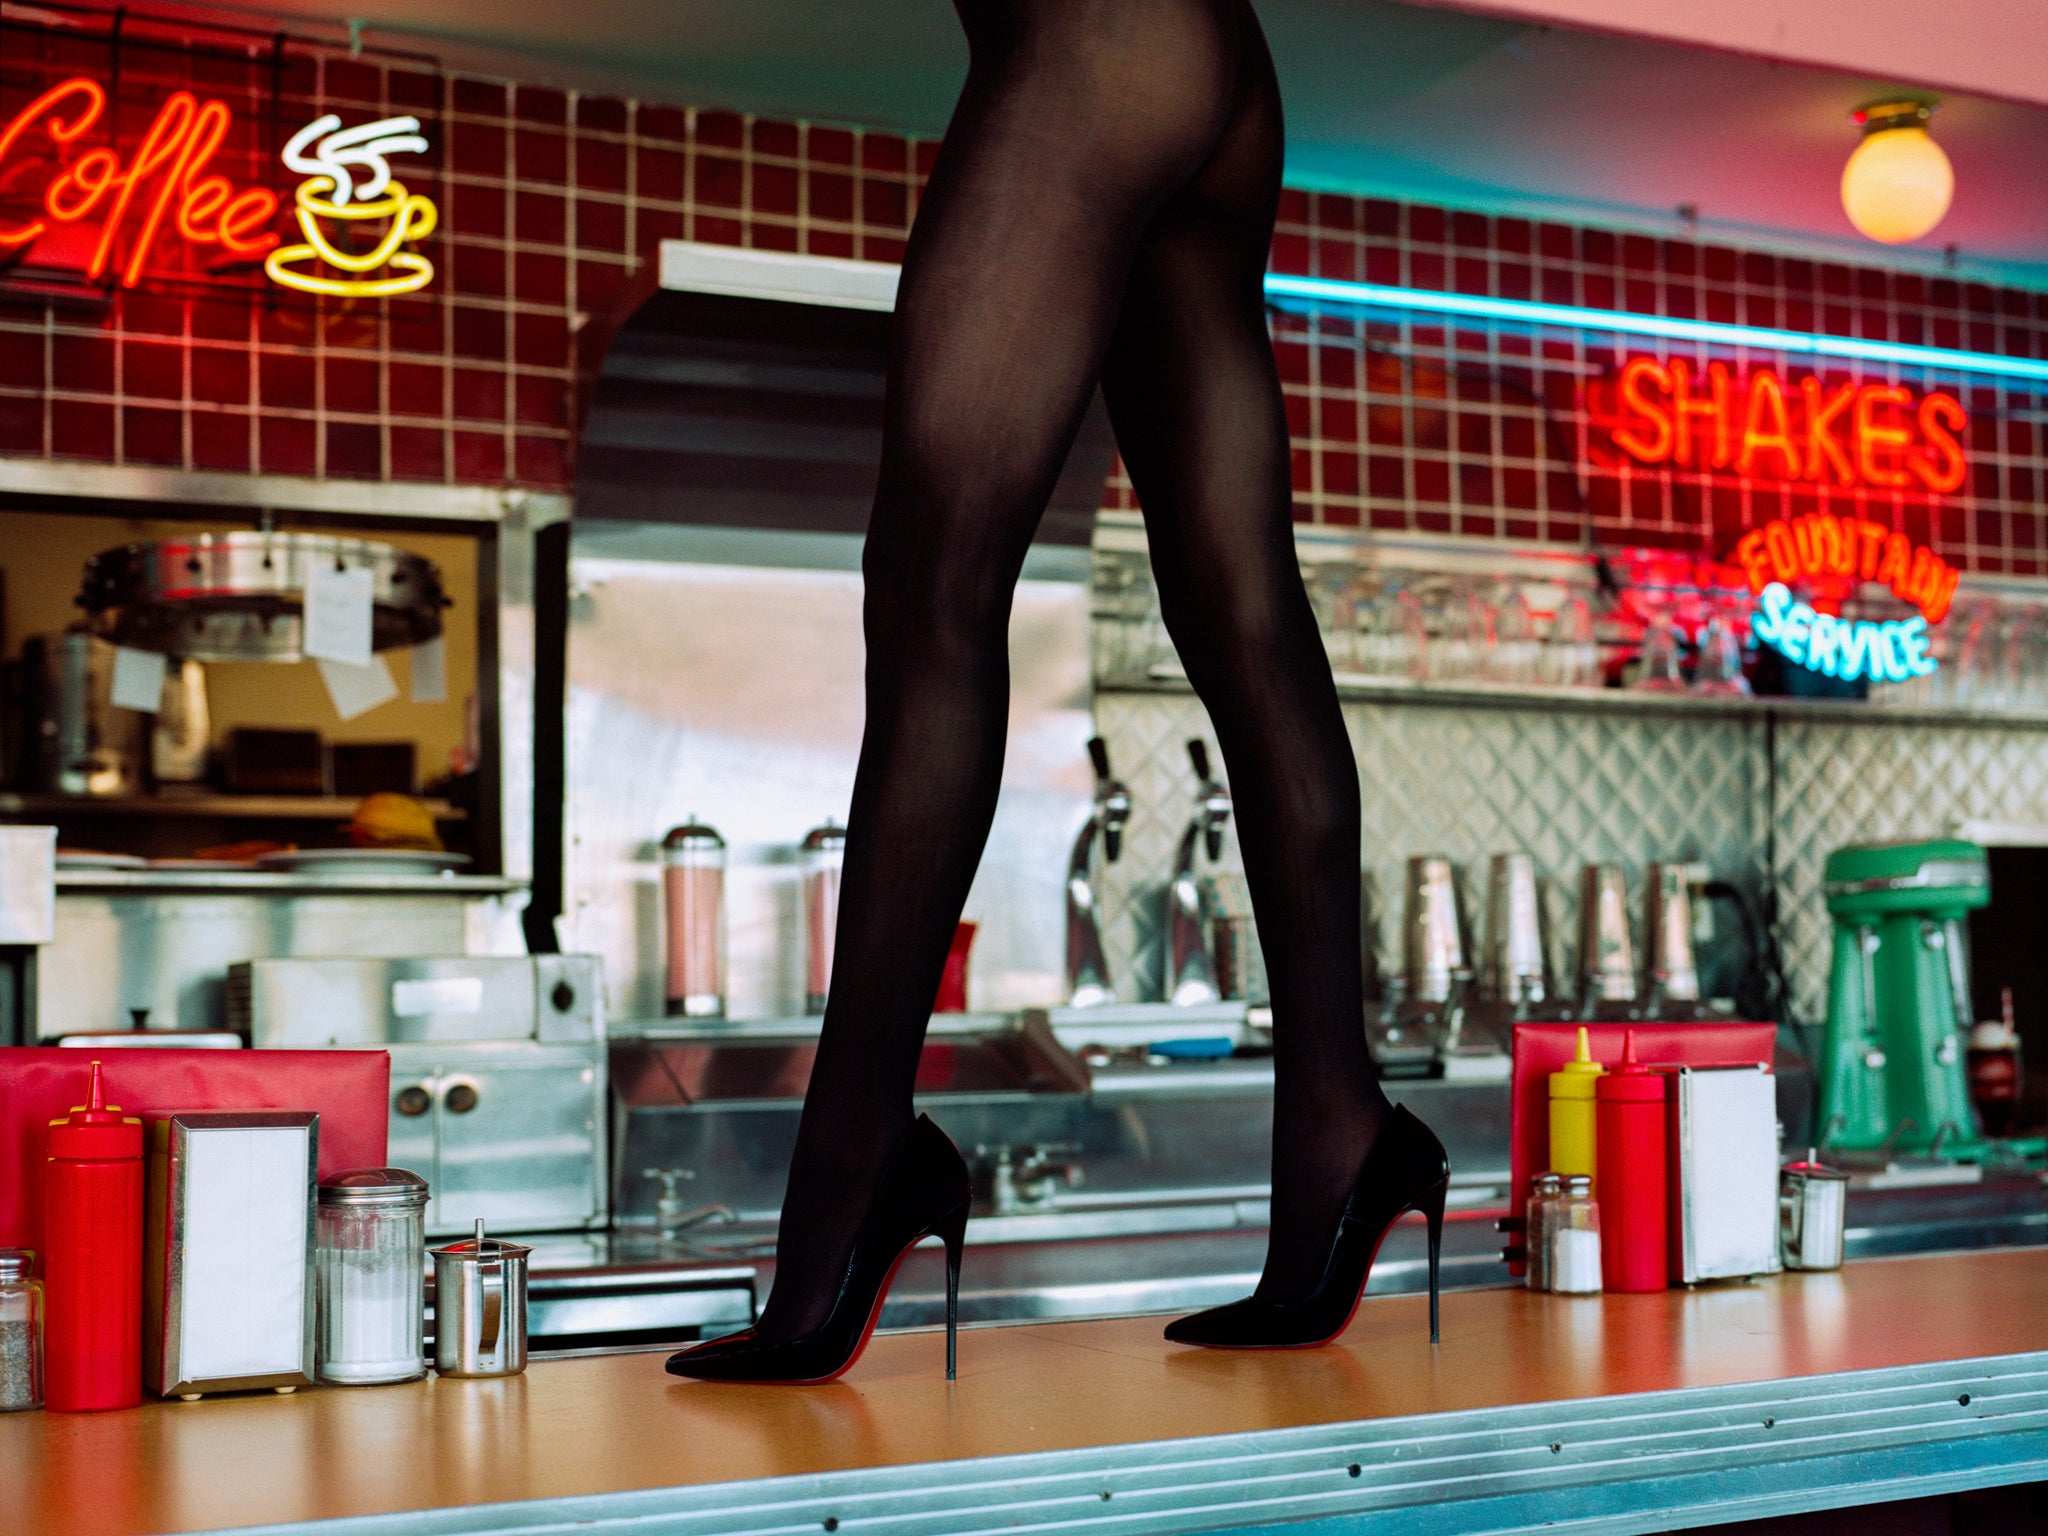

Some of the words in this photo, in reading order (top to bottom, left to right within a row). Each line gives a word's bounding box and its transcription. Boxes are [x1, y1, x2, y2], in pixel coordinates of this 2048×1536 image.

[0, 77, 281, 288] Coffee
[1611, 356, 1968, 493] SHAKES
[1737, 512, 1961, 624] FOUNTAIN
[1751, 582, 1939, 682] SERVICE
